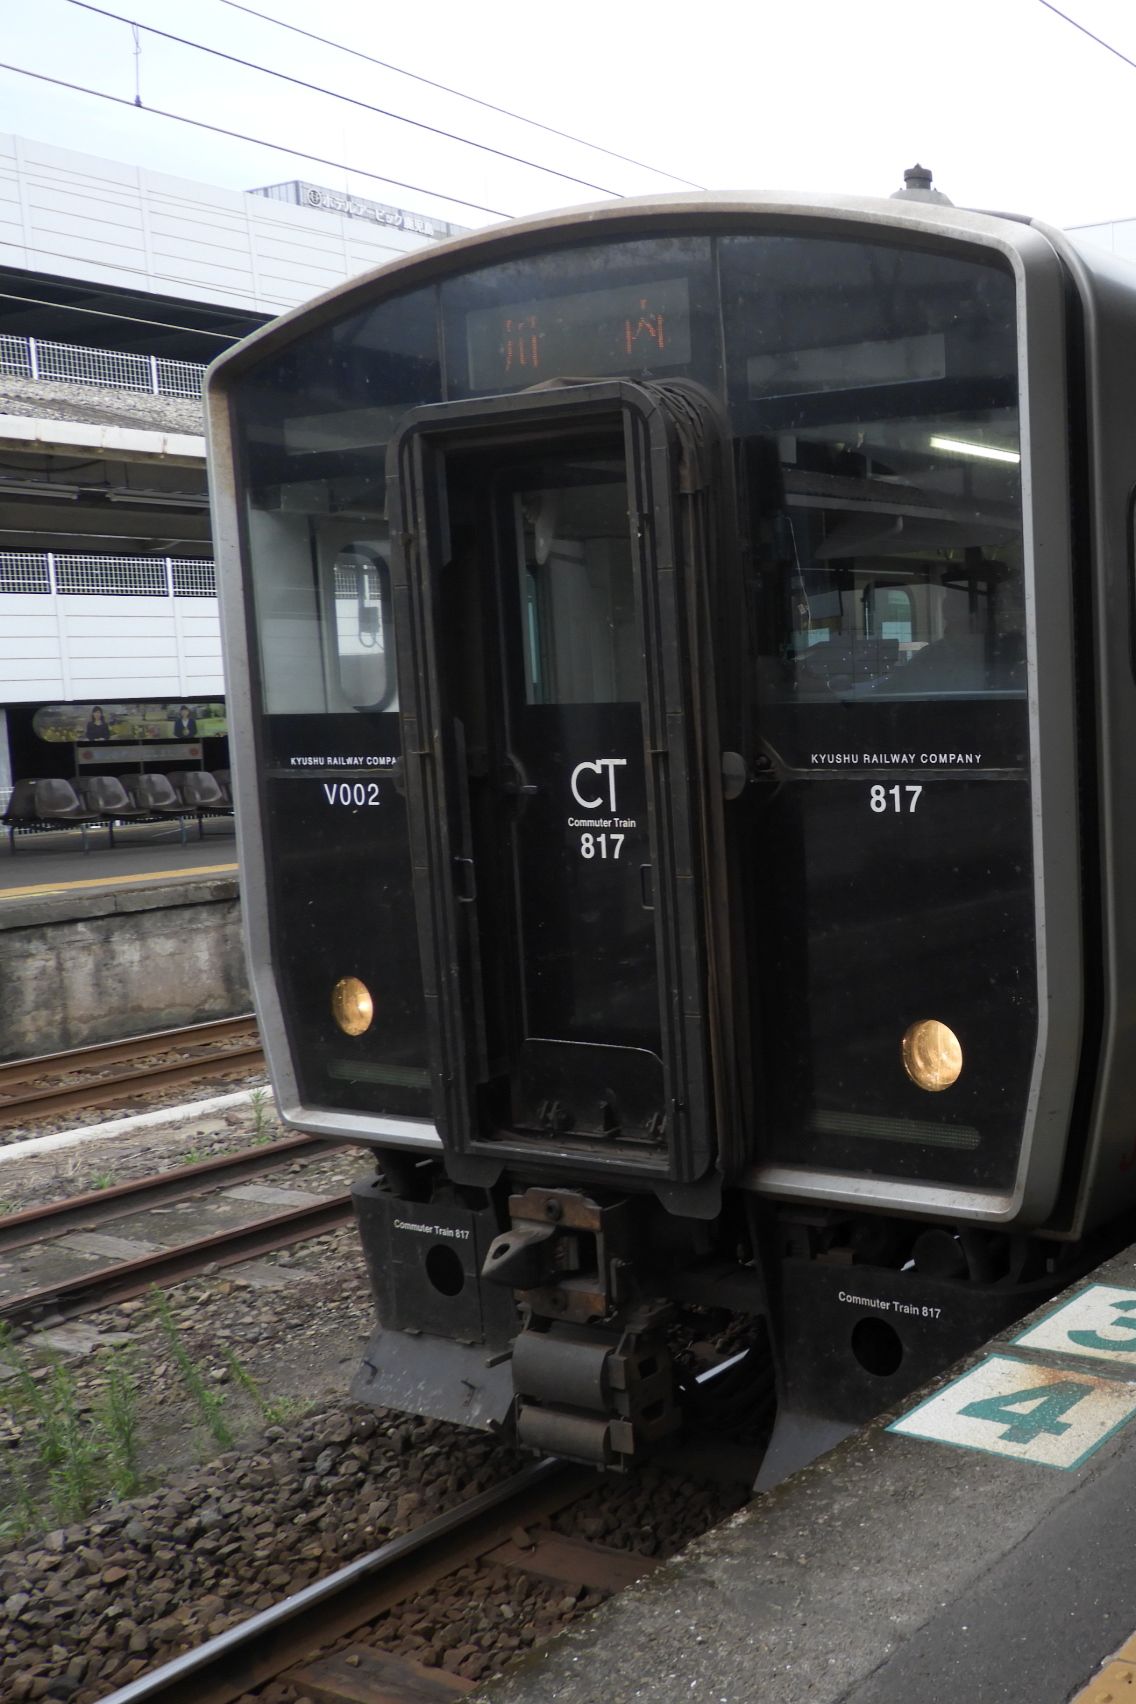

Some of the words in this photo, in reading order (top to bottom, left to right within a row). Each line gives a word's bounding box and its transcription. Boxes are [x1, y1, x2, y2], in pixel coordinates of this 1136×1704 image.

[290, 757, 325, 765] KYUSHU
[327, 757, 363, 765] RAILWAY
[811, 753, 859, 764] KYUSHU
[863, 753, 916, 764] RAILWAY
[920, 753, 982, 764] COMPANY
[323, 783, 381, 806] V002
[571, 758, 627, 812] CT
[869, 784, 923, 813] 817
[567, 817, 612, 828] Commuter
[613, 817, 637, 828] Train
[580, 832, 625, 859] 817
[393, 1219, 433, 1234] Commuter
[434, 1225, 454, 1237] Train
[455, 1229, 470, 1240] 817
[838, 1291, 891, 1310] Commuter
[892, 1301, 920, 1315] Train
[922, 1306, 941, 1319] 817
[956, 1379, 1096, 1444] 4
